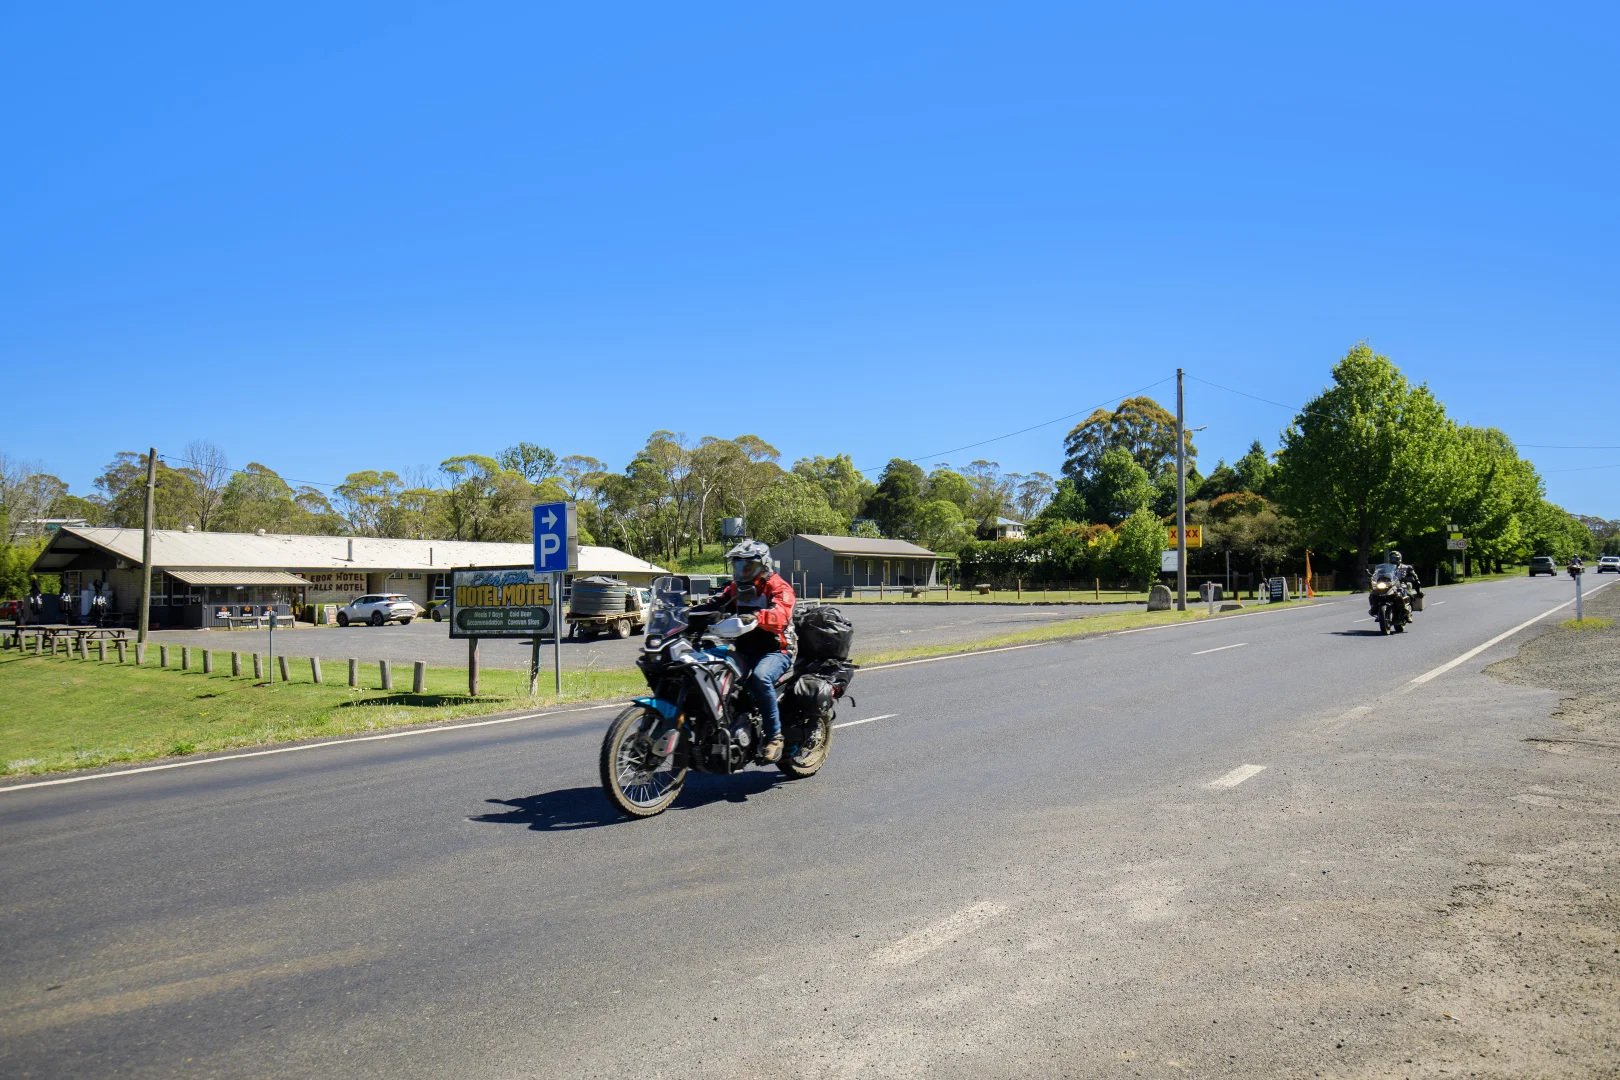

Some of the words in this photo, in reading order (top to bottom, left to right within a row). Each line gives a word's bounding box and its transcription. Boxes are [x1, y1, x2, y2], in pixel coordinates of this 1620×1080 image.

[1170, 530, 1198, 538] XXX
[541, 534, 560, 567] P
[336, 572, 364, 581] HOTEL
[471, 574, 500, 586] Ebor
[500, 571, 534, 589] Falls
[336, 583, 364, 591] MOTEL
[456, 586, 502, 607] HOTEL
[502, 583, 553, 606] MOTEL
[492, 611, 503, 619] Days
